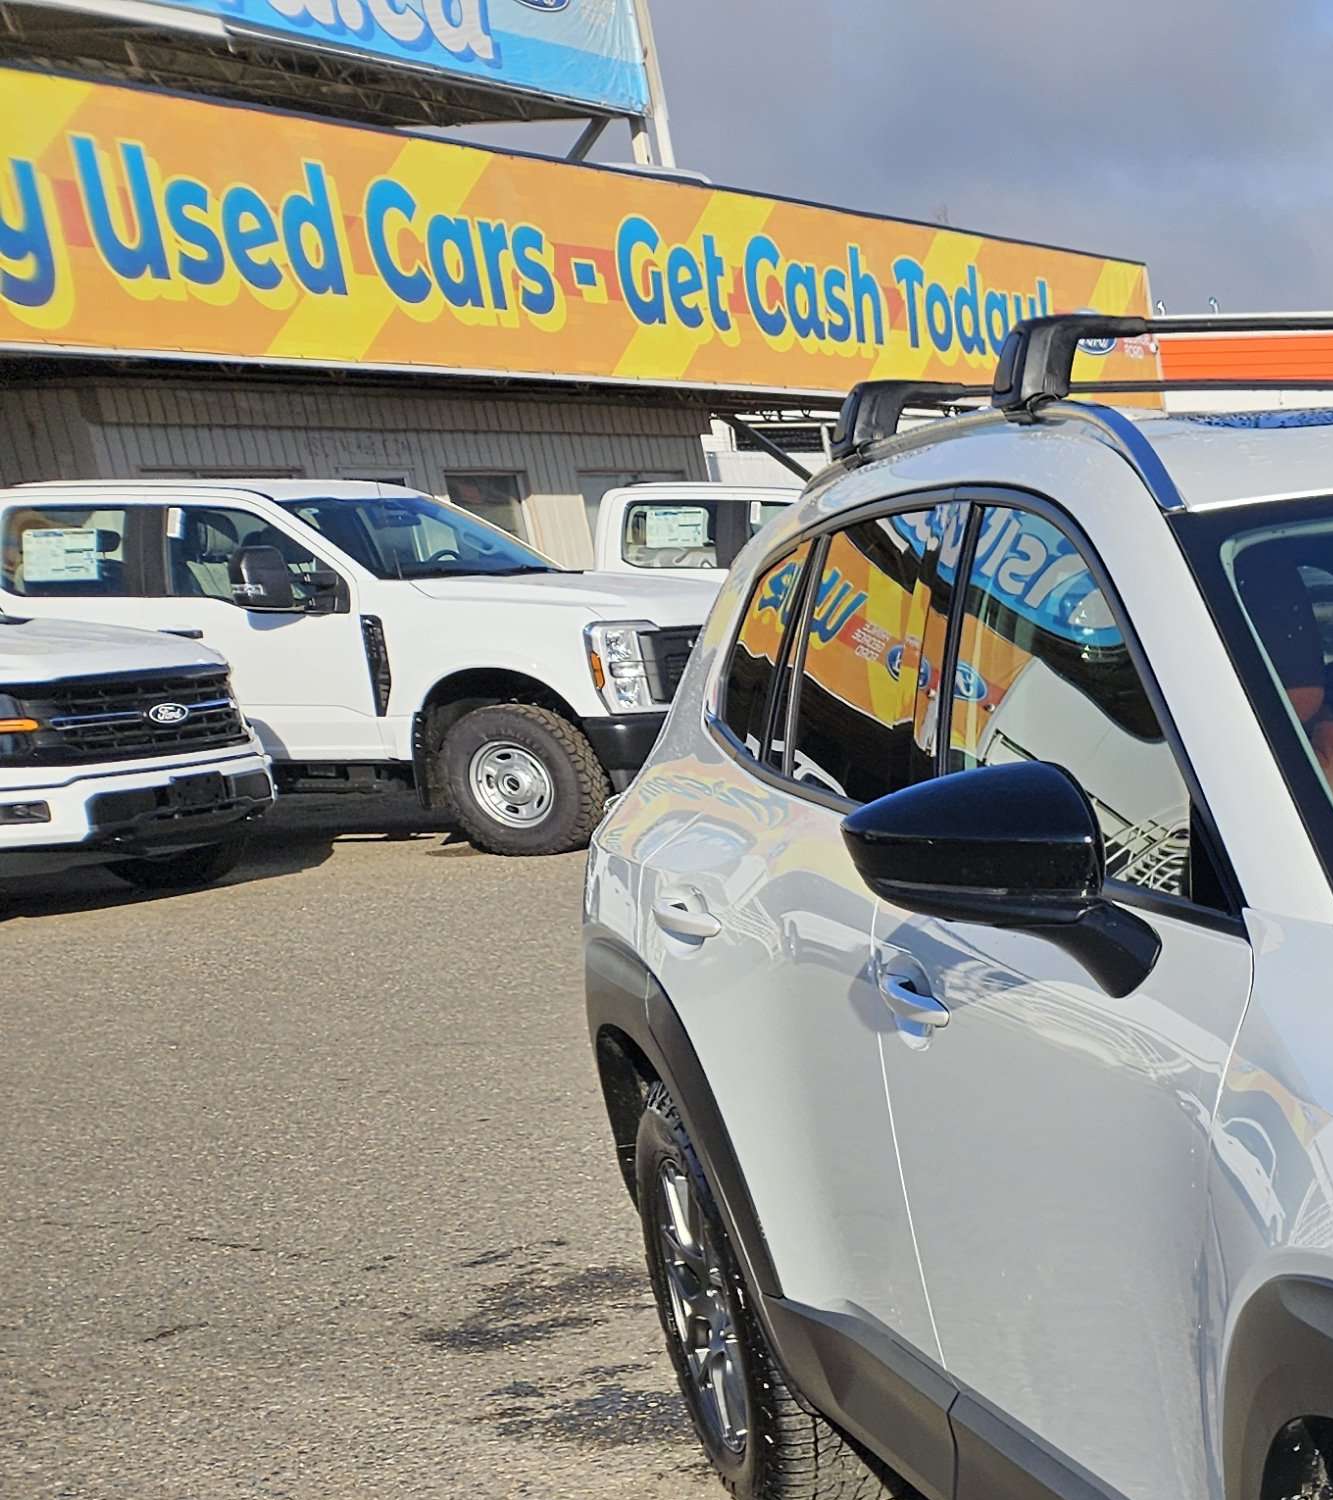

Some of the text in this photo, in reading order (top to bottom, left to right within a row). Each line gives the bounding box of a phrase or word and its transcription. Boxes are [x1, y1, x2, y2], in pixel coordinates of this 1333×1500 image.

[69, 133, 349, 295] Used
[365, 179, 556, 315] Cars
[617, 216, 732, 332] Get
[744, 234, 885, 346] Cash
